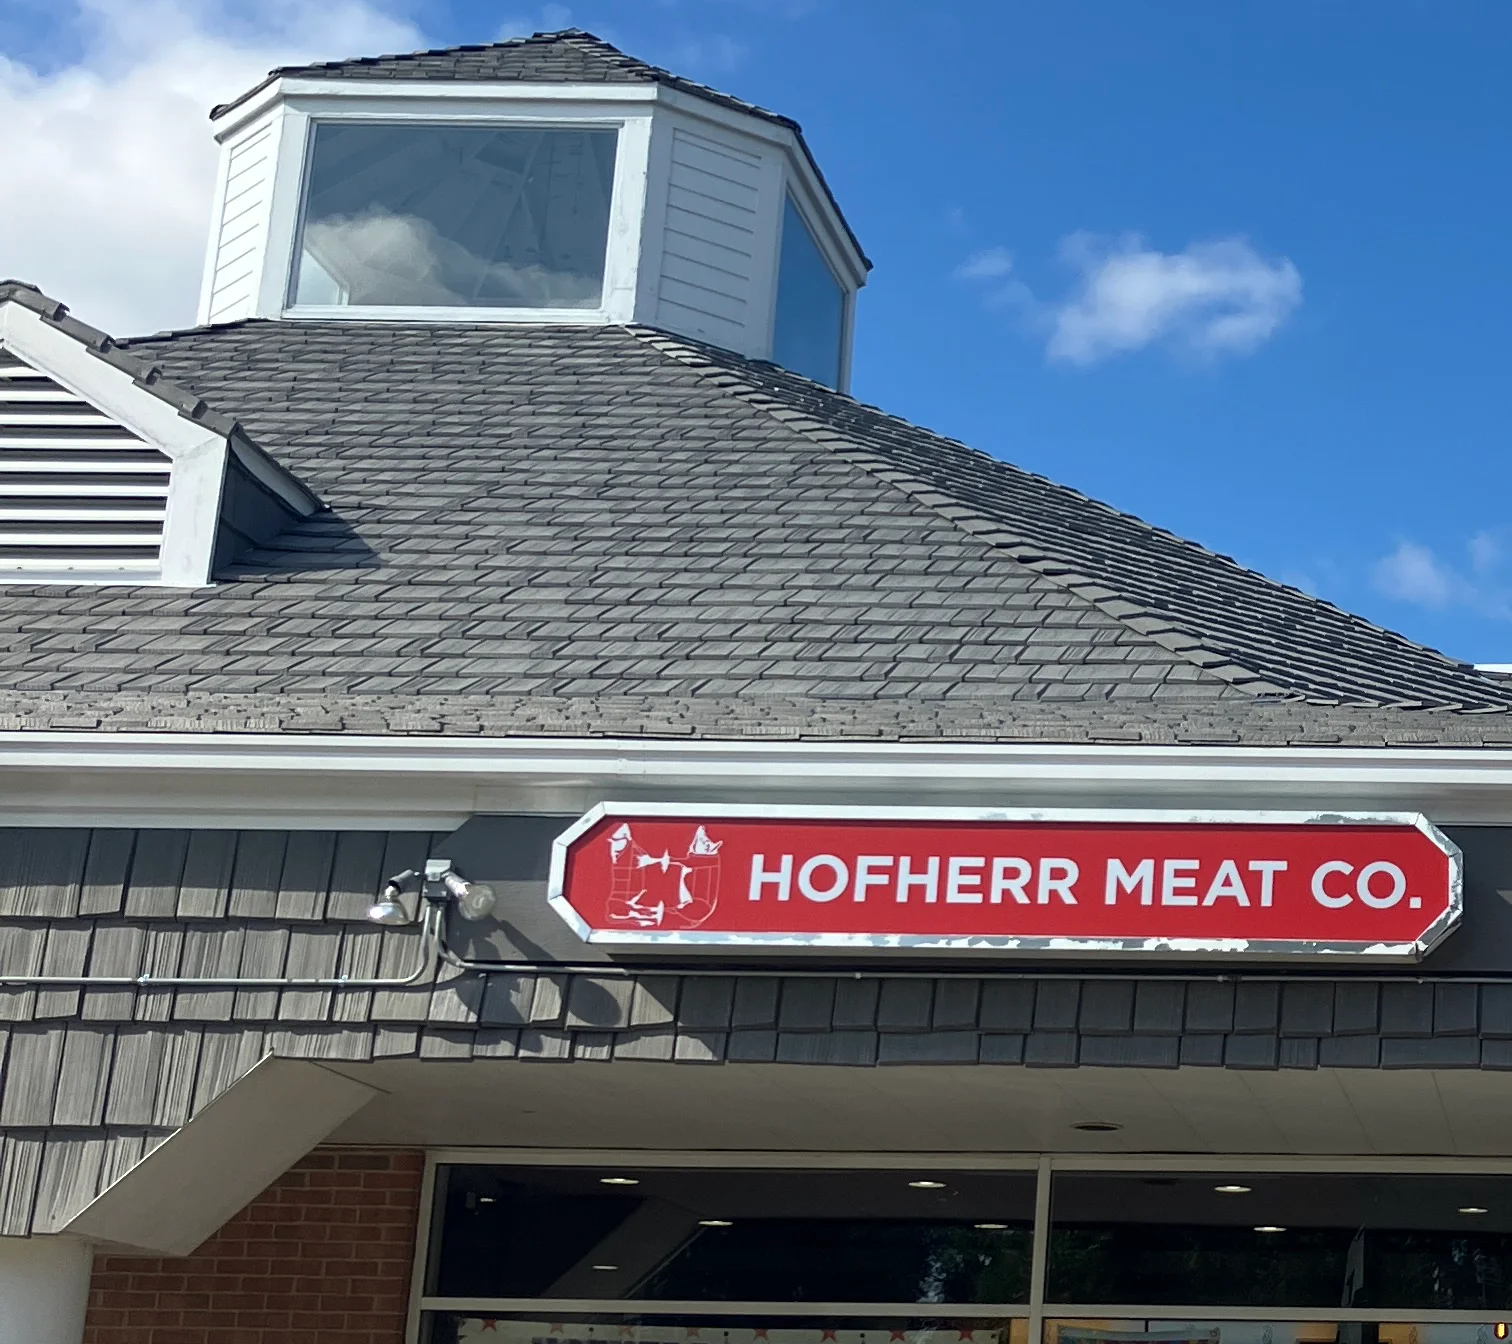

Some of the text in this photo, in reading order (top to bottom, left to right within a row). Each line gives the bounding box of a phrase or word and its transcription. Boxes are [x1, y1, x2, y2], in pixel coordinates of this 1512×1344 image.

[748, 852, 1424, 909] HOFHERR MEAT CO.
